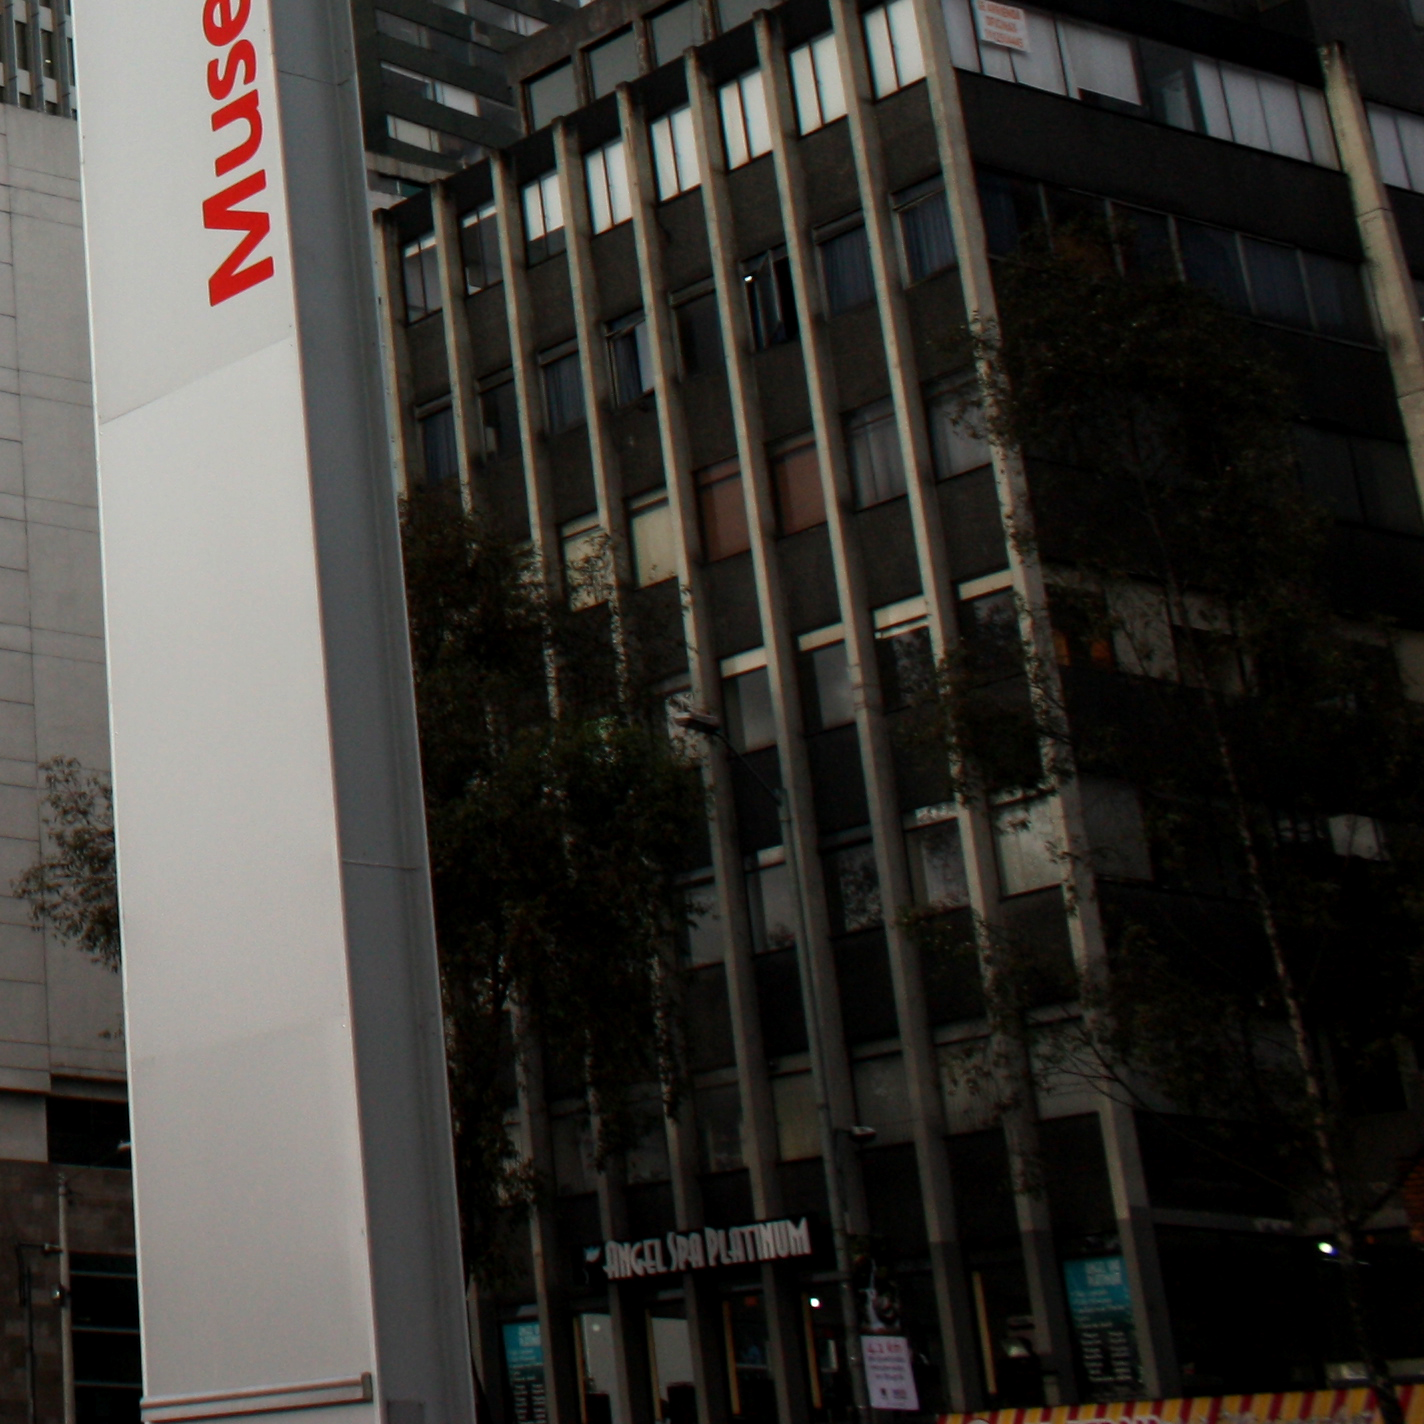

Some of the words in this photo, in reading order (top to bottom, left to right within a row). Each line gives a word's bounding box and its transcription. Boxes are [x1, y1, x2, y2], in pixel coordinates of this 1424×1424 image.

[602, 1238, 668, 1280] ANGEL
[666, 1231, 706, 1273] SPA
[704, 1217, 813, 1267] PLATINUM
